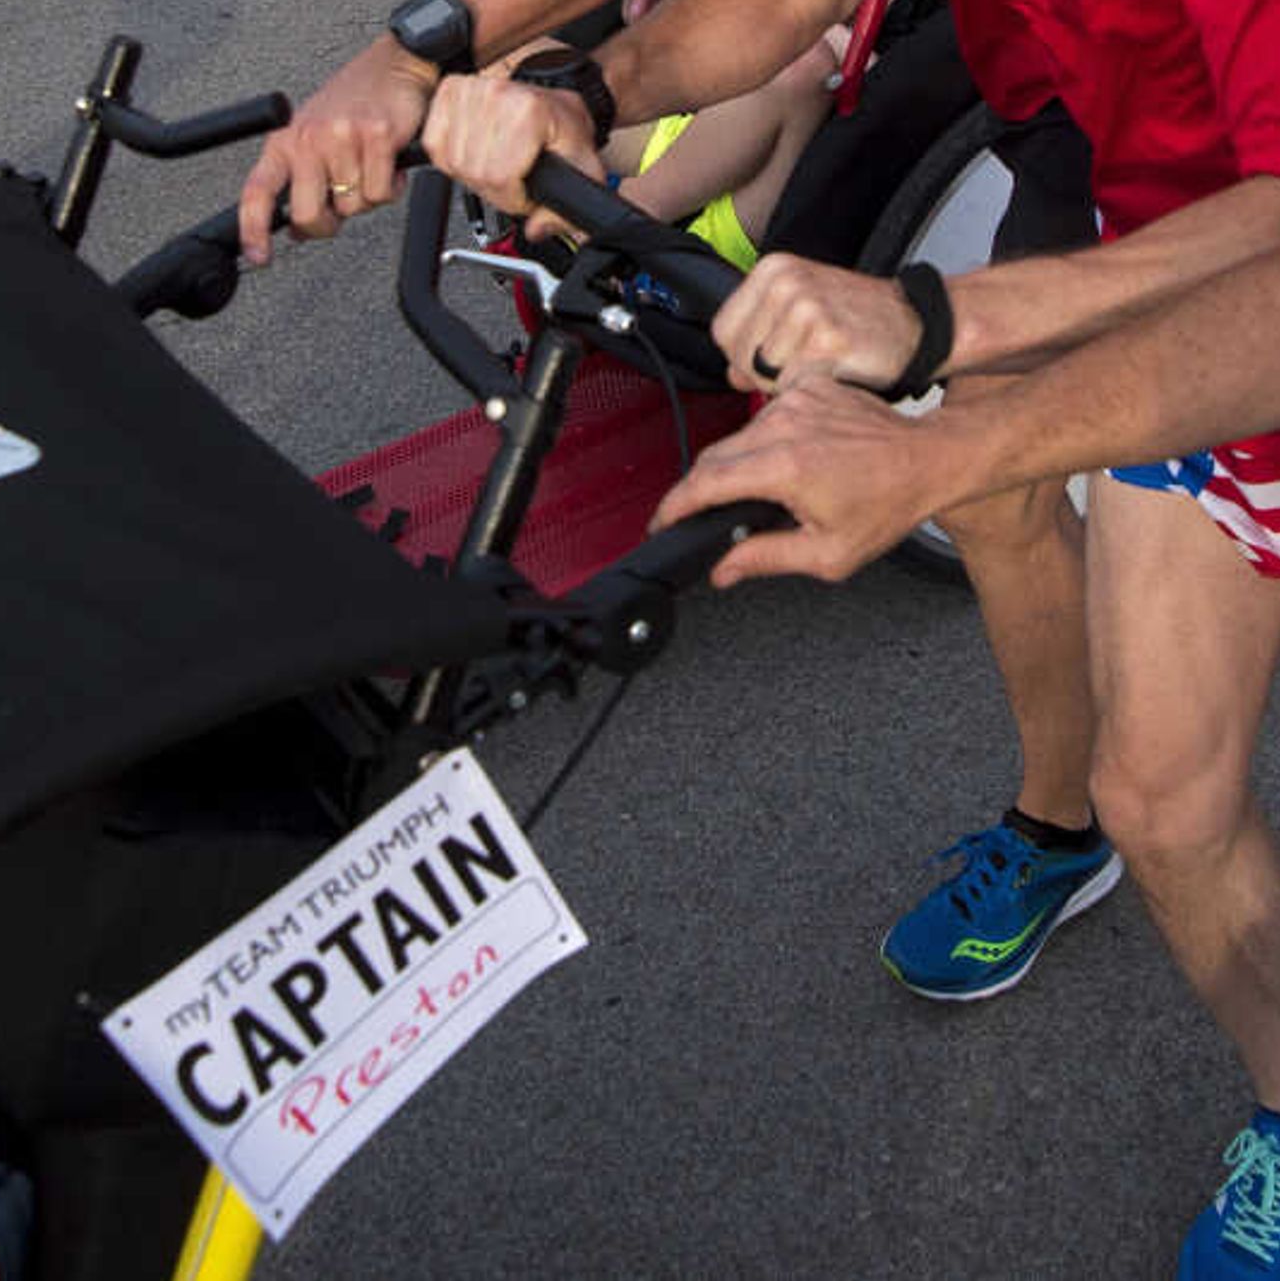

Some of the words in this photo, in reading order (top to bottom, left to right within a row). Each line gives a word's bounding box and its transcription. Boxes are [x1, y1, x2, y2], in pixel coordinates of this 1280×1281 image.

[164, 912, 303, 1036] myTEAM
[298, 792, 450, 918] TRIUMPH
[176, 810, 520, 1129] CAPTAIN
[278, 944, 501, 1136] Preston
